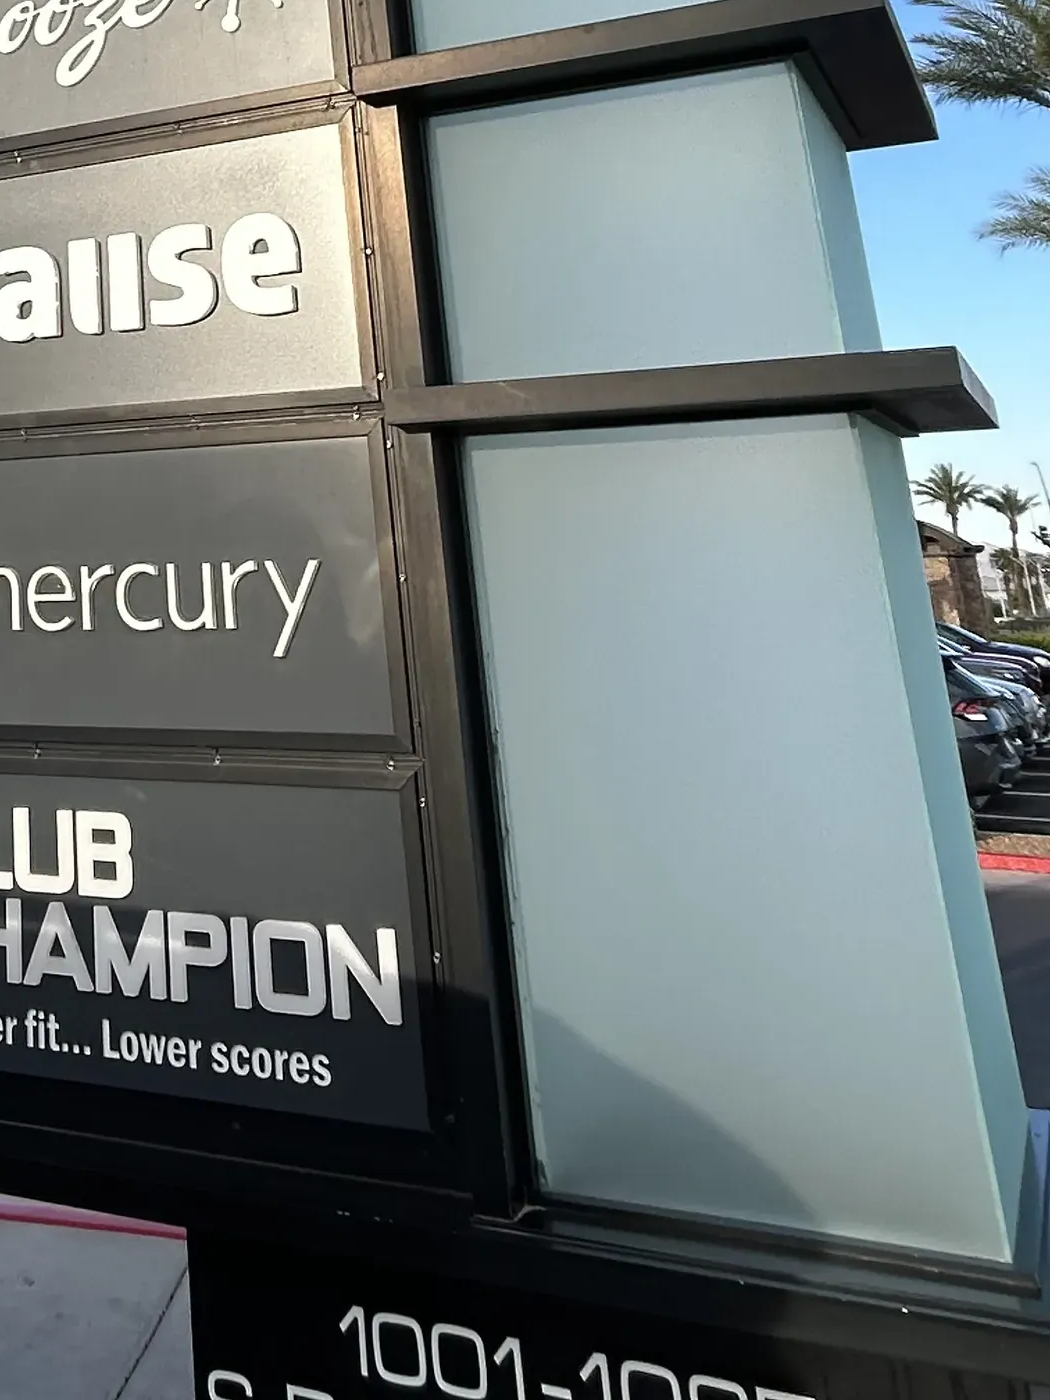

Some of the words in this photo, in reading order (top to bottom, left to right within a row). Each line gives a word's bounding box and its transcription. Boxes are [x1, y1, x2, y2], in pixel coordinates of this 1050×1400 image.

[23, 1007, 93, 1056] fit...
[101, 1018, 202, 1070] Lower
[210, 1041, 333, 1088] scores
